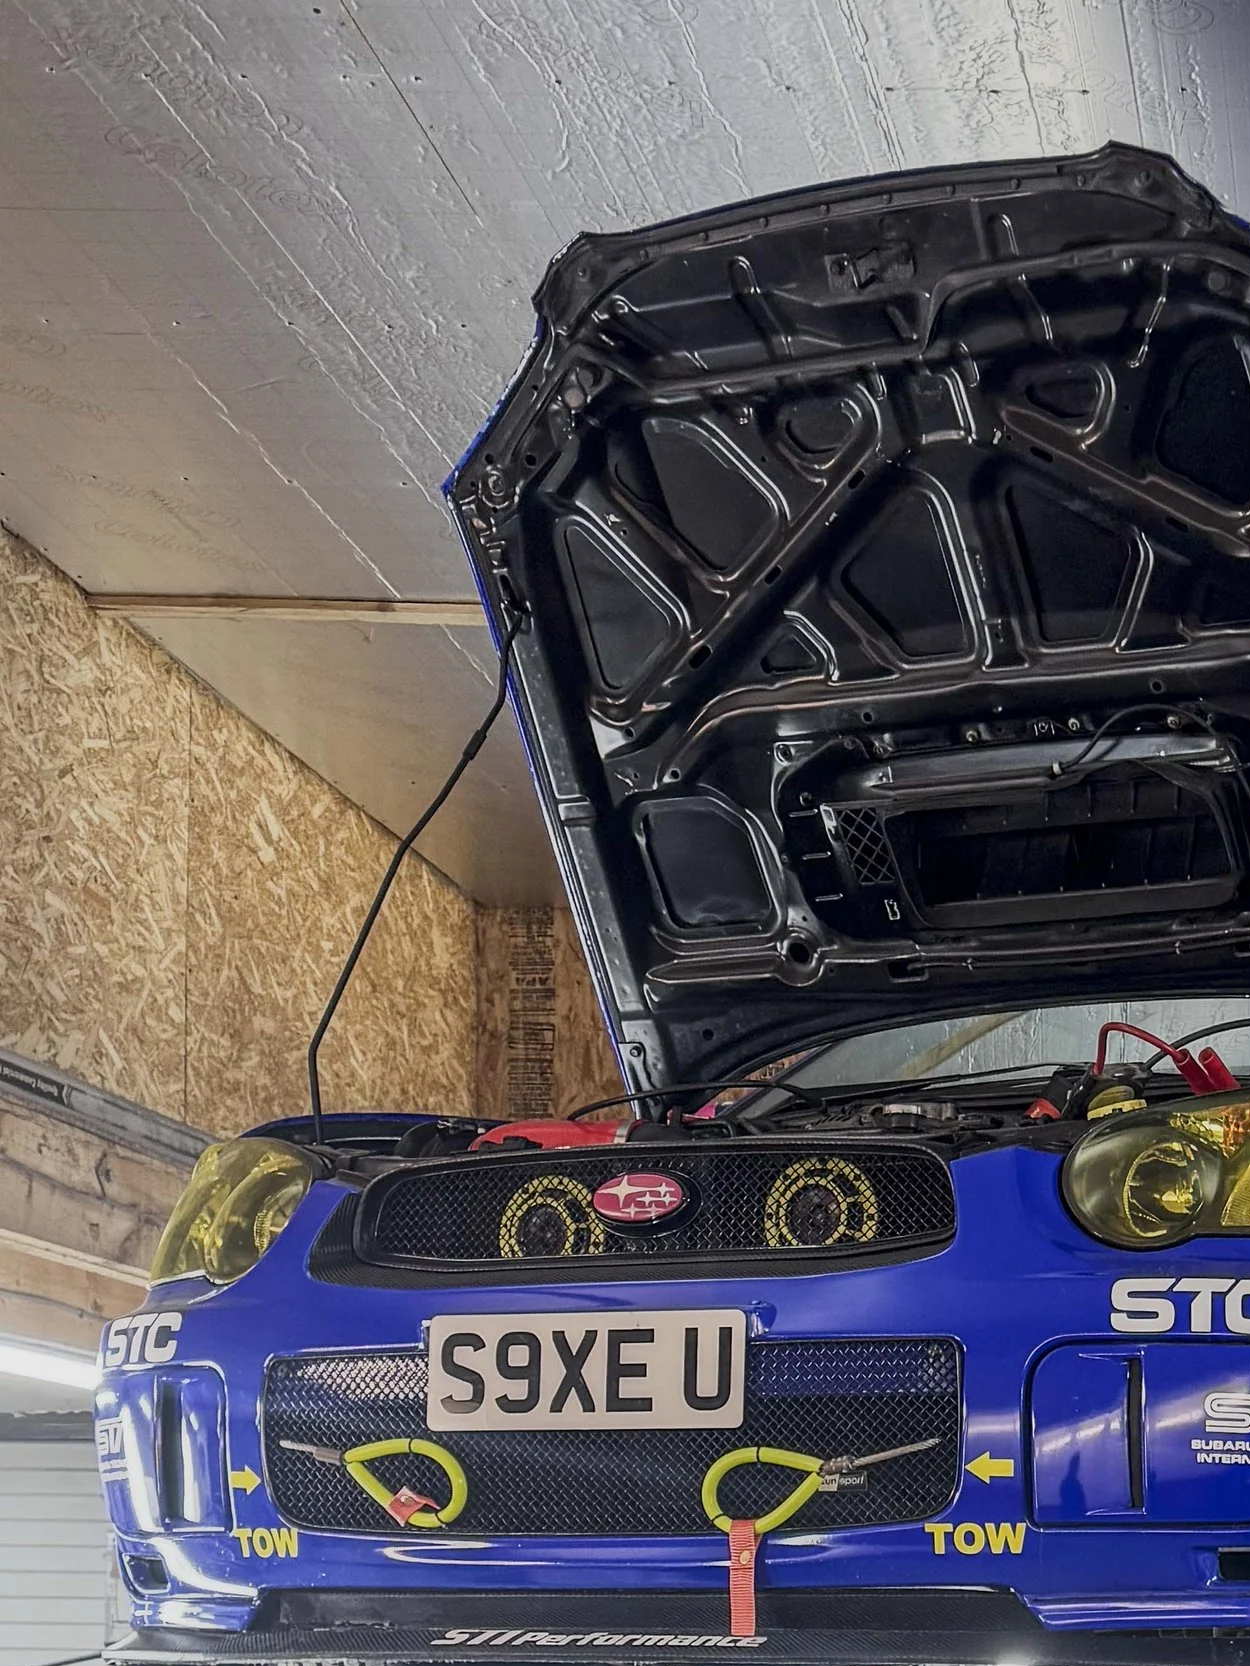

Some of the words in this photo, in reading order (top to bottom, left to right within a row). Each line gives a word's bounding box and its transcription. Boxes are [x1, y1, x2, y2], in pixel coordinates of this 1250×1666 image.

[105, 1312, 183, 1368] STC
[440, 1328, 655, 1414] S9XE
[683, 1326, 733, 1411] U
[234, 1527, 299, 1558] TOW
[924, 1522, 1027, 1555] TOW
[515, 1631, 768, 1648] Performance
